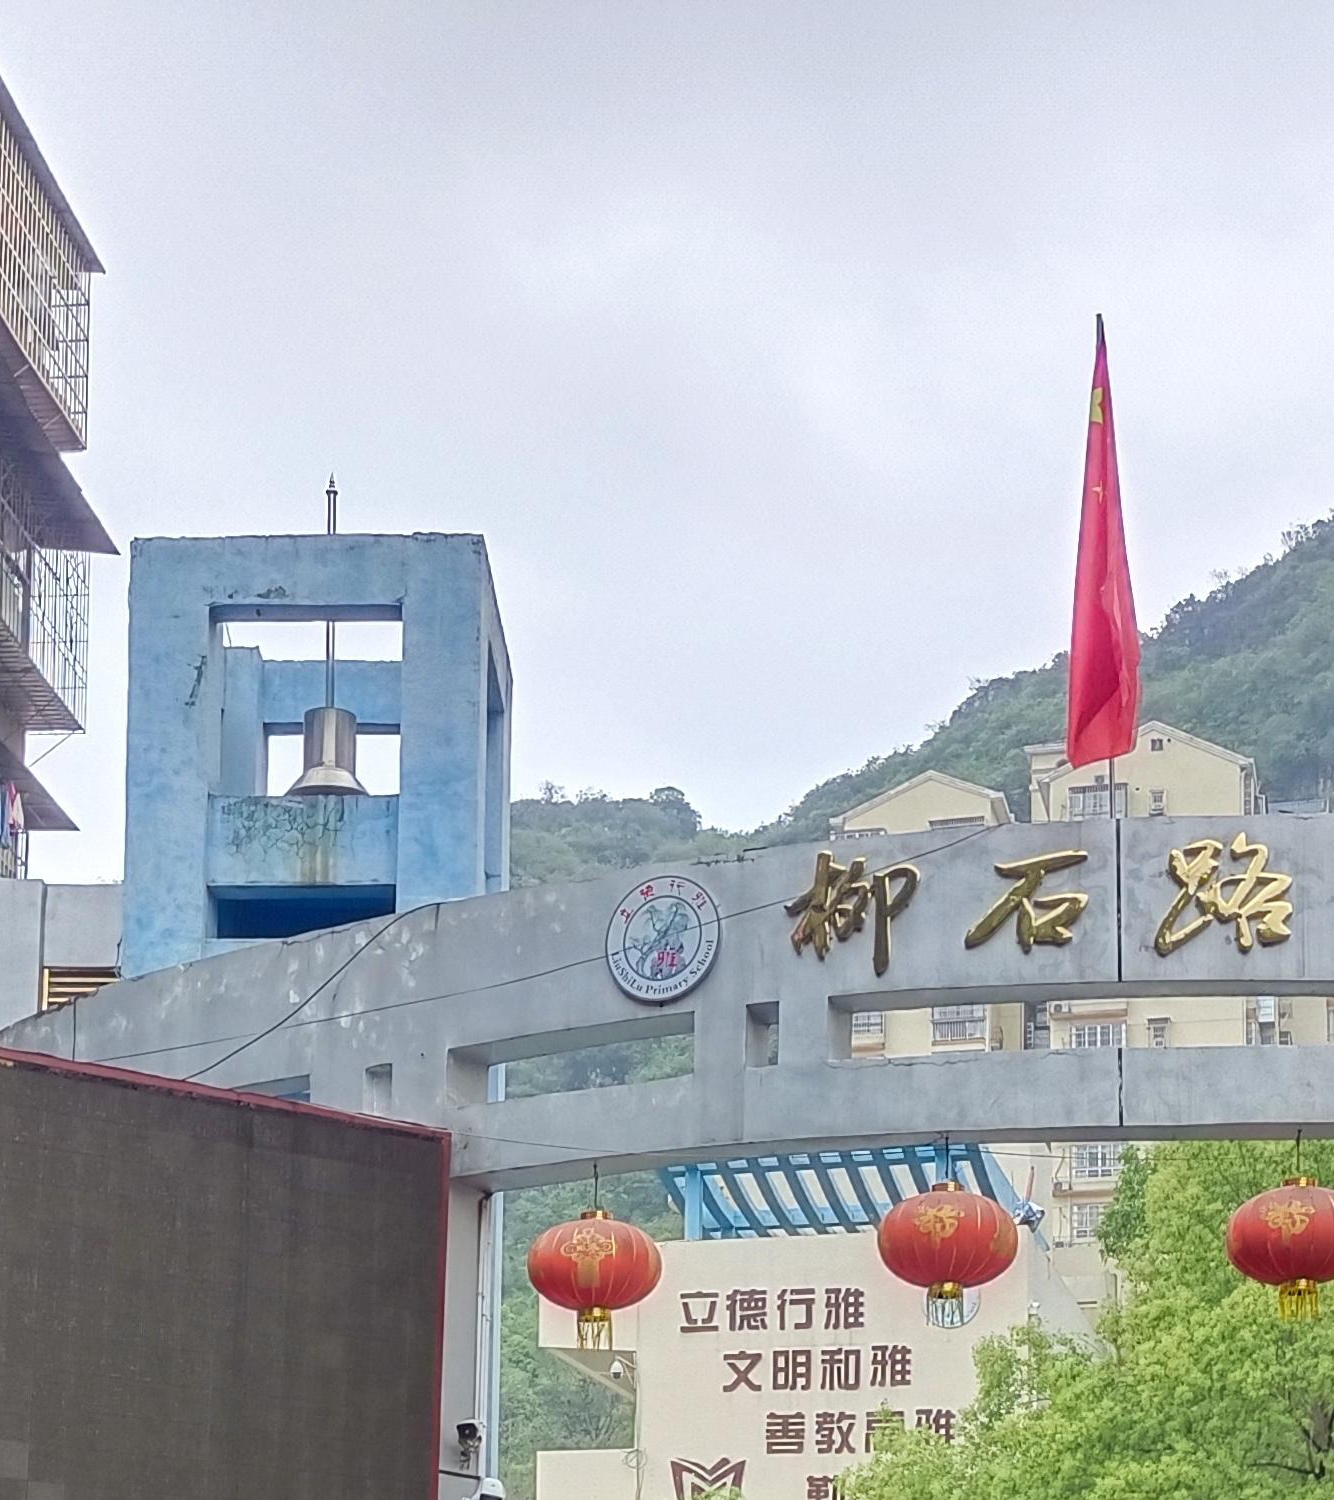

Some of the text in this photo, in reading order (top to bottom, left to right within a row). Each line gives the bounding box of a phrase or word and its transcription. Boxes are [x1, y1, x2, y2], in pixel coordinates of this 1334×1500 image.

[645, 976, 689, 996] Primary
[689, 938, 715, 977] School
[678, 1286, 866, 1334] 立德行雅
[722, 1344, 913, 1393] 文明和雅
